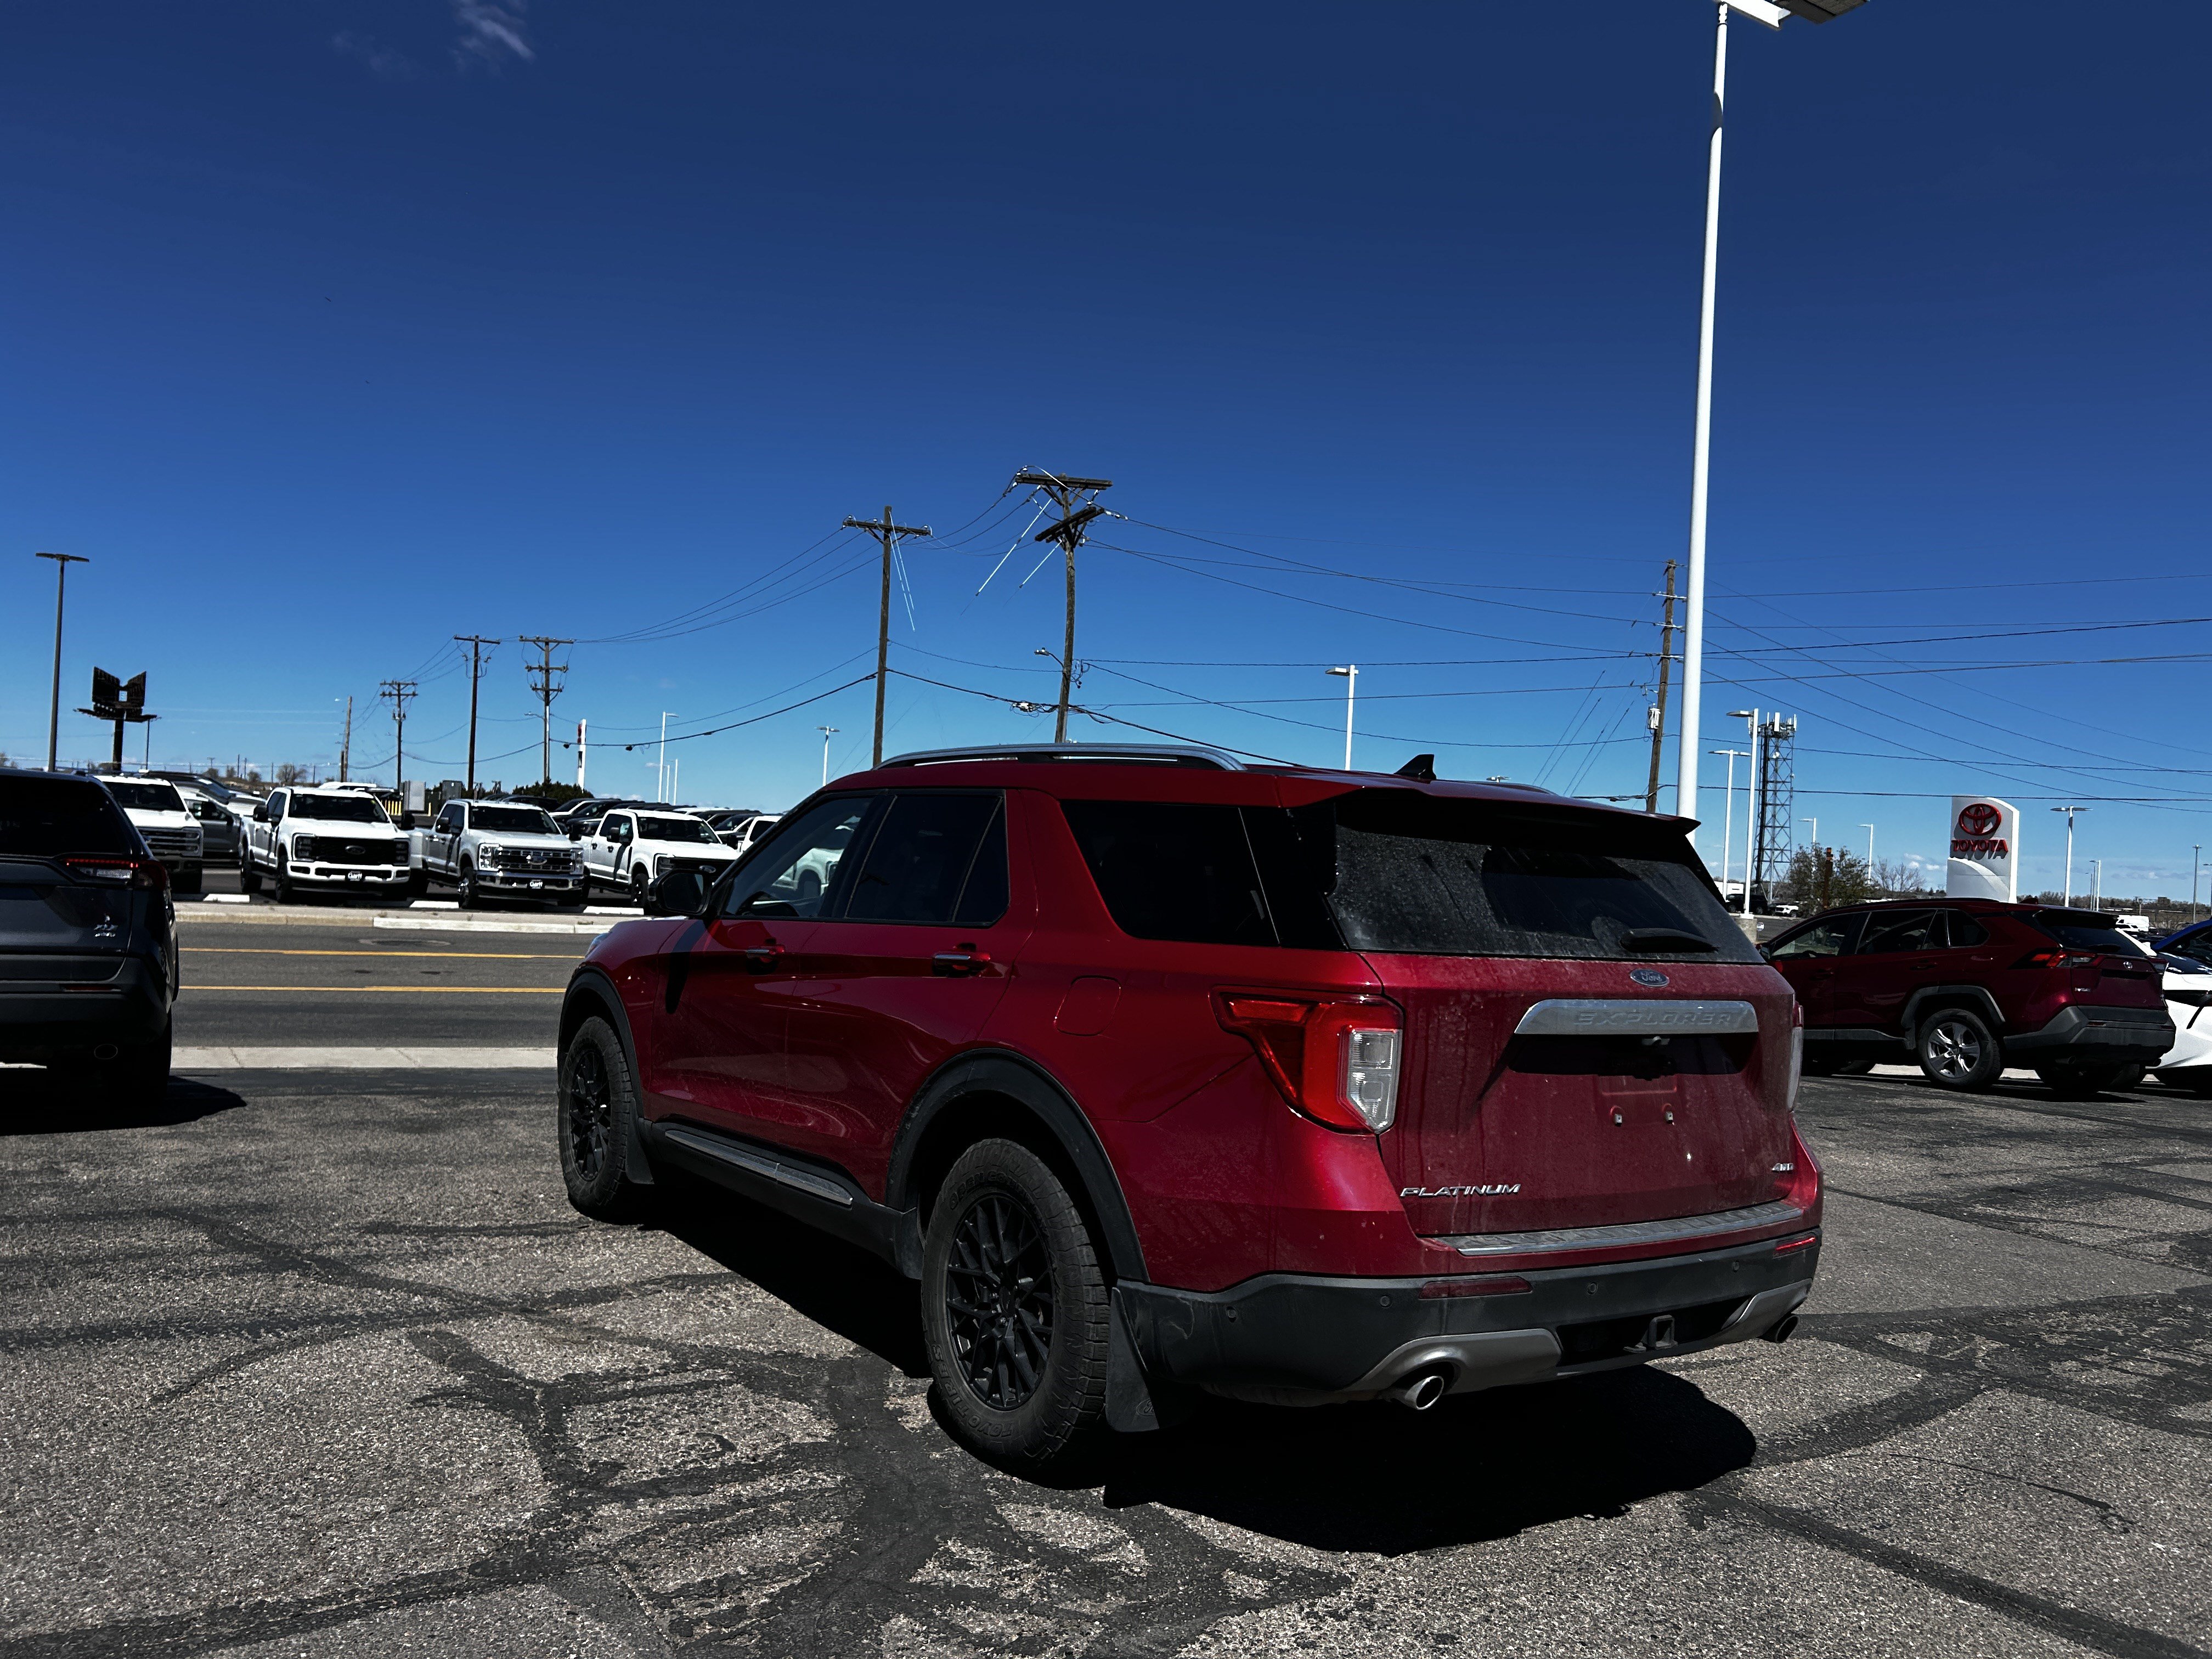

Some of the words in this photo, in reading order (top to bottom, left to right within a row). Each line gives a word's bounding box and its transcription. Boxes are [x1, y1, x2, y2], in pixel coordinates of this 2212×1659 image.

[1951, 839, 2008, 851] TOYOTA
[1640, 971, 1663, 982] Ford
[1573, 1012, 1731, 1025] EXPLORER
[1400, 1183, 1521, 1197] PLATINUM
[933, 1345, 969, 1418] TIRES
[968, 1414, 1012, 1437] TOYO
